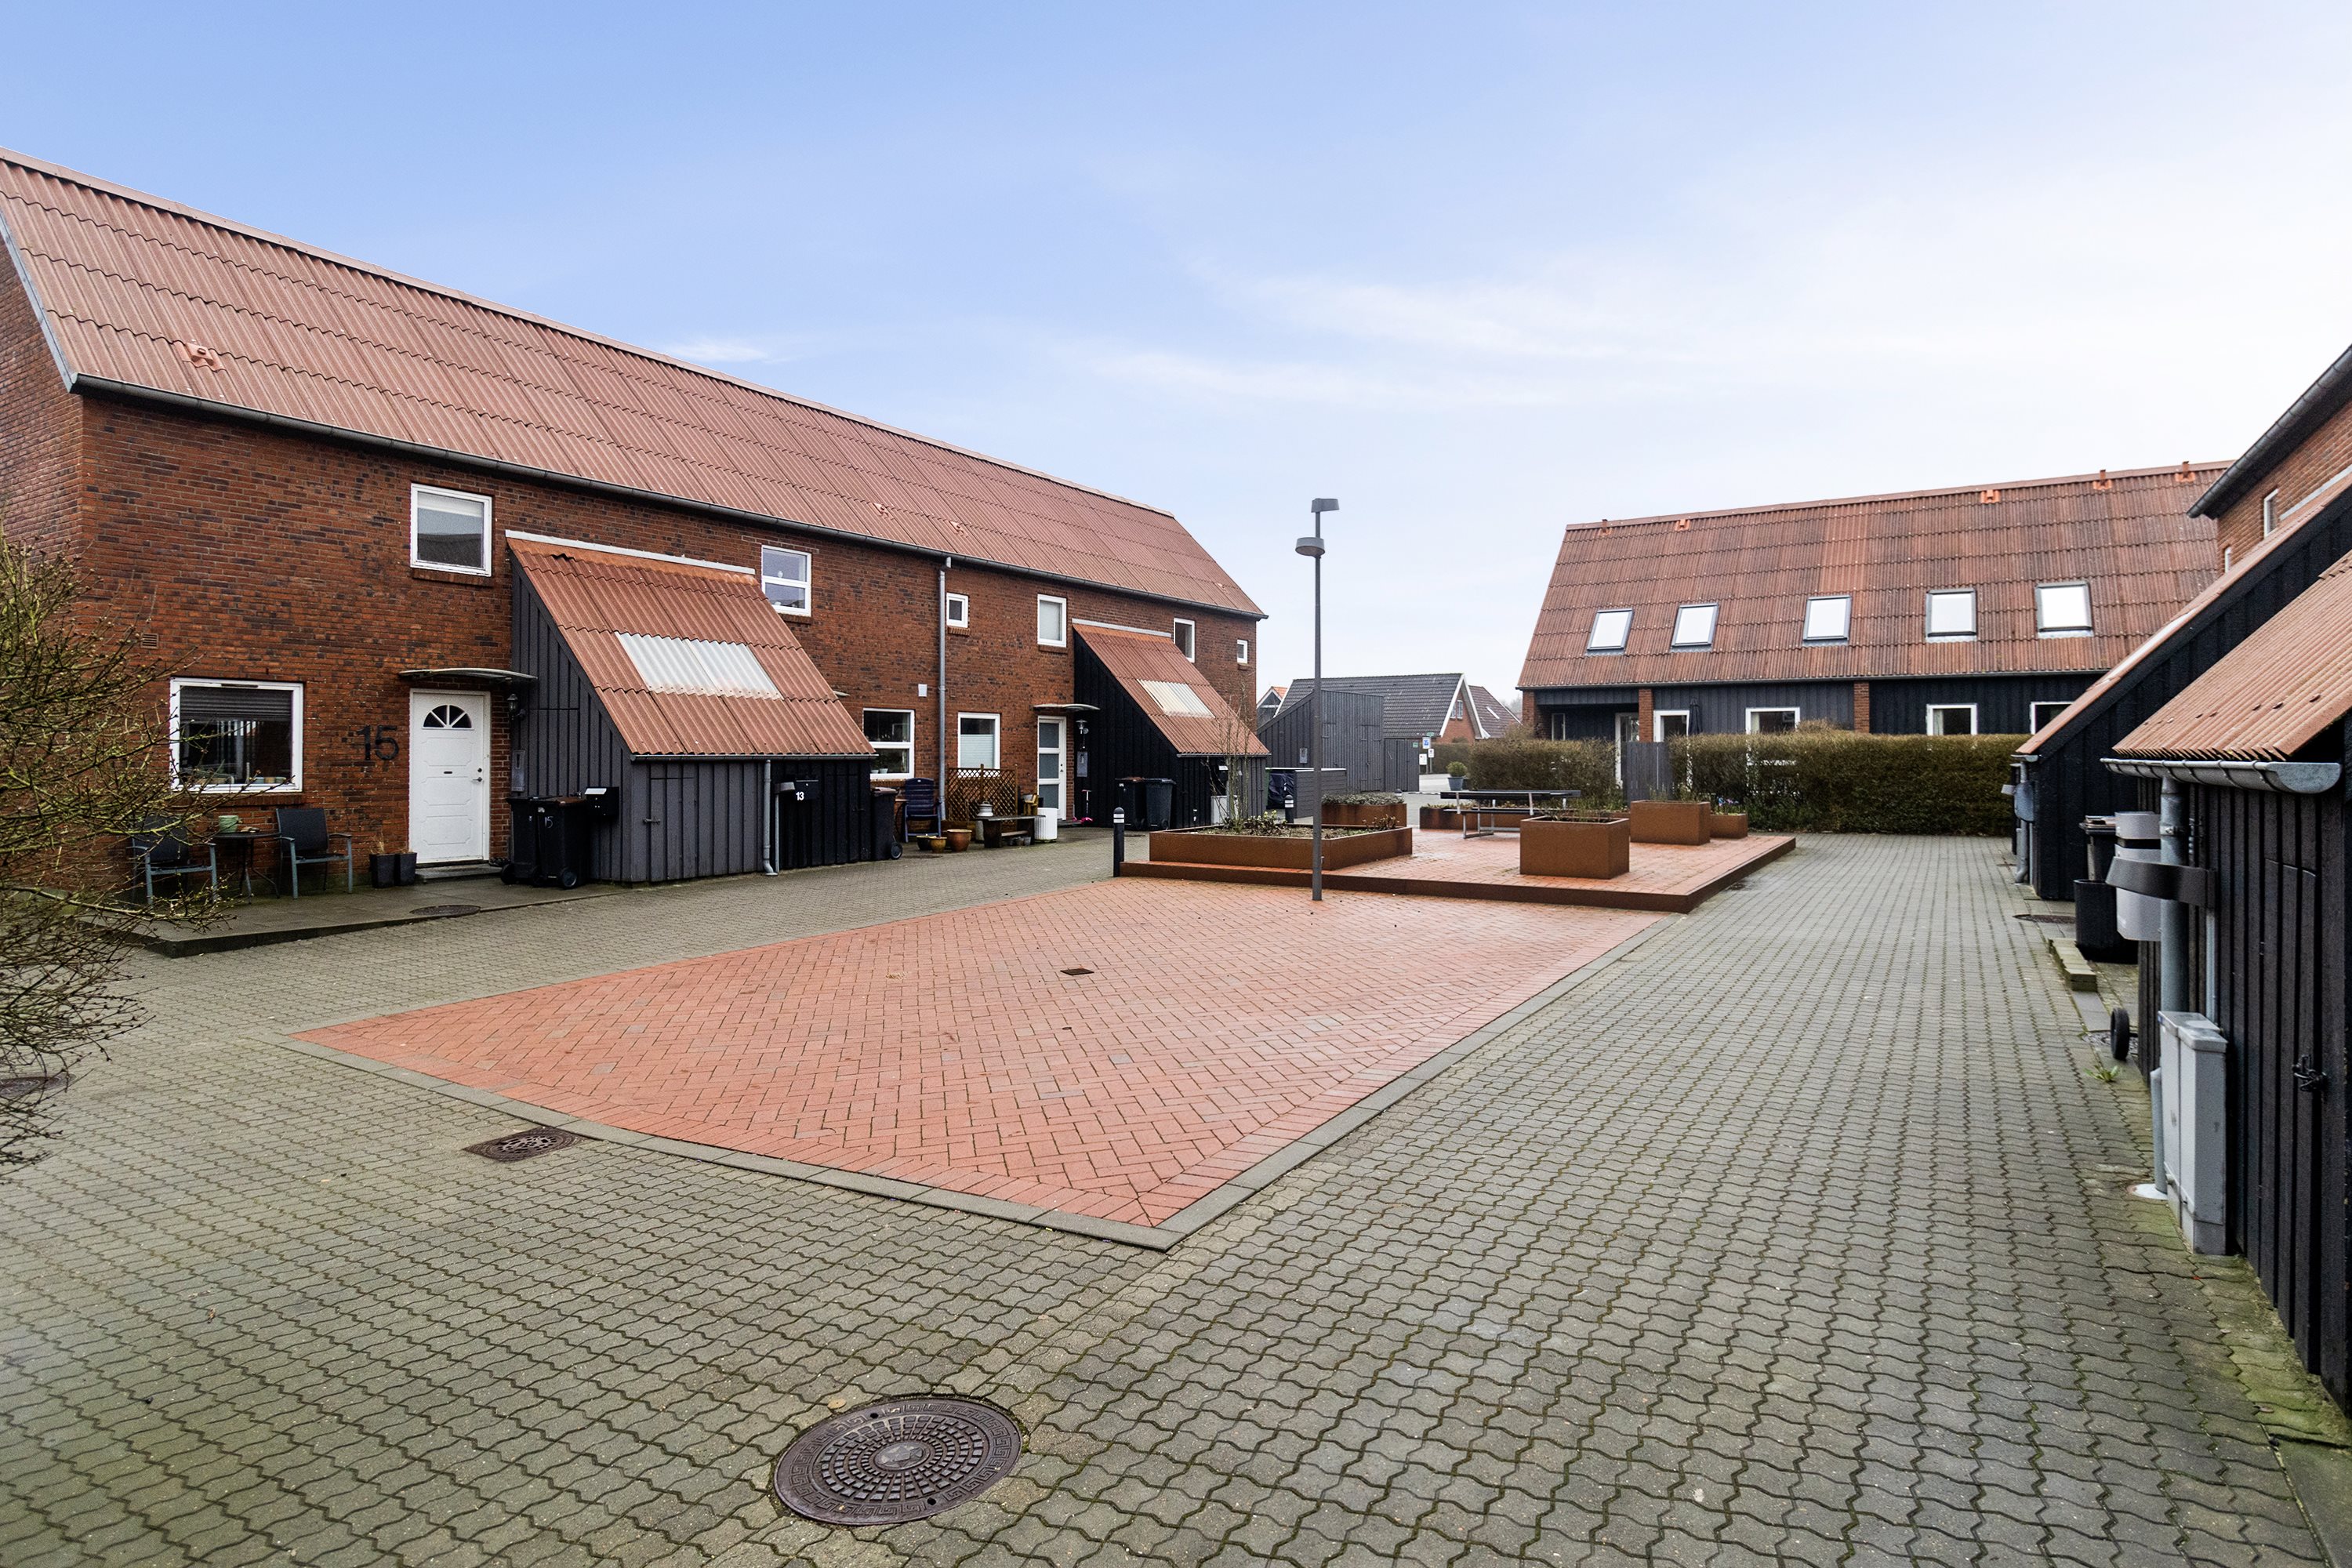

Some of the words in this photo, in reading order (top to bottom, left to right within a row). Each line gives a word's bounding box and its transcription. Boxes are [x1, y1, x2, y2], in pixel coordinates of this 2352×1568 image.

[357, 724, 399, 760] 15
[796, 791, 804, 800] 13
[544, 815, 554, 829] 15
